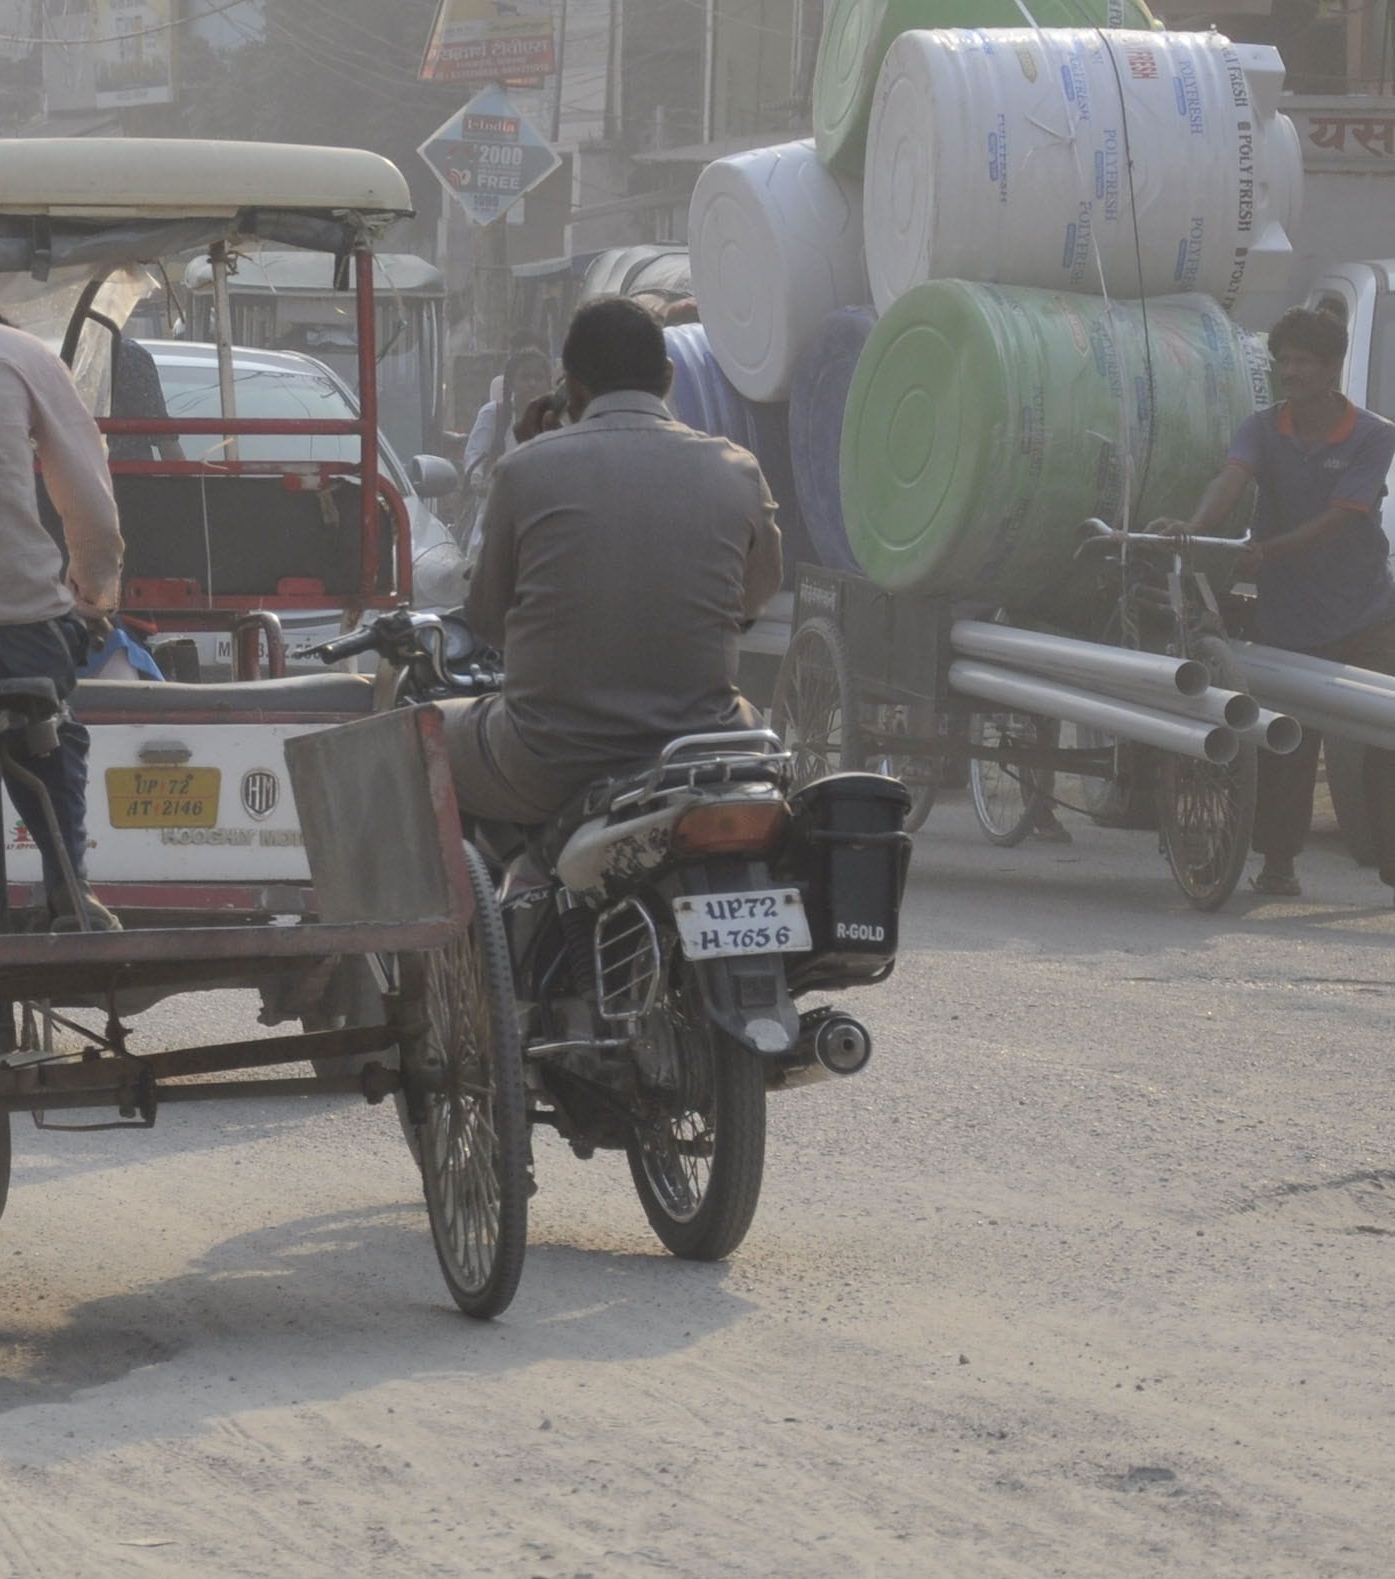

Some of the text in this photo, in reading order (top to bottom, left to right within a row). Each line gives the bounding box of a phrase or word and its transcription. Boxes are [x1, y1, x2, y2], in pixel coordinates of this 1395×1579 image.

[1179, 60, 1204, 136] POLYFRESH
[476, 175, 522, 190] FREE
[1104, 129, 1118, 221] POLYFRESH
[1238, 134, 1254, 232] POLY FRESH
[248, 774, 274, 812] HM
[836, 922, 885, 941] R-GOLD
